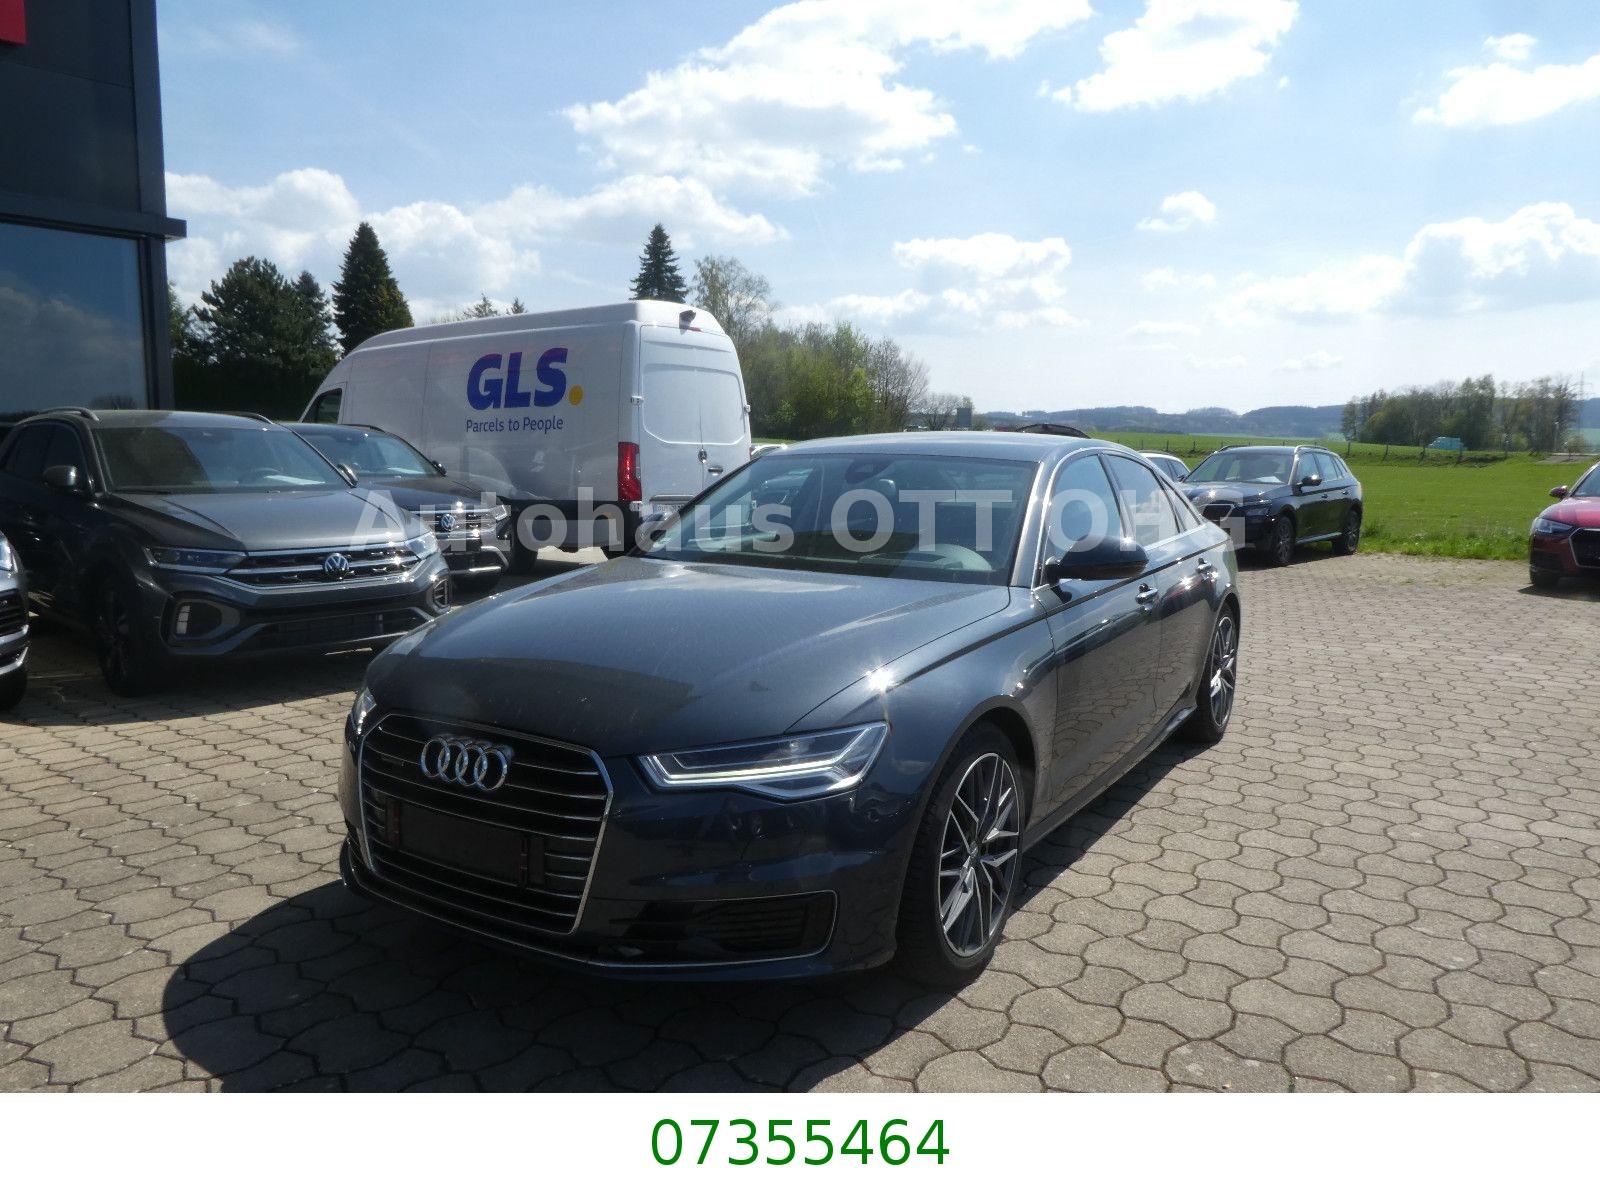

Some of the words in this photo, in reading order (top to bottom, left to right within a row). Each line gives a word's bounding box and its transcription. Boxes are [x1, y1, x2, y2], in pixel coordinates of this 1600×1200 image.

[466, 418, 505, 433] Parcels
[508, 419, 520, 431] to
[523, 415, 564, 434] People
